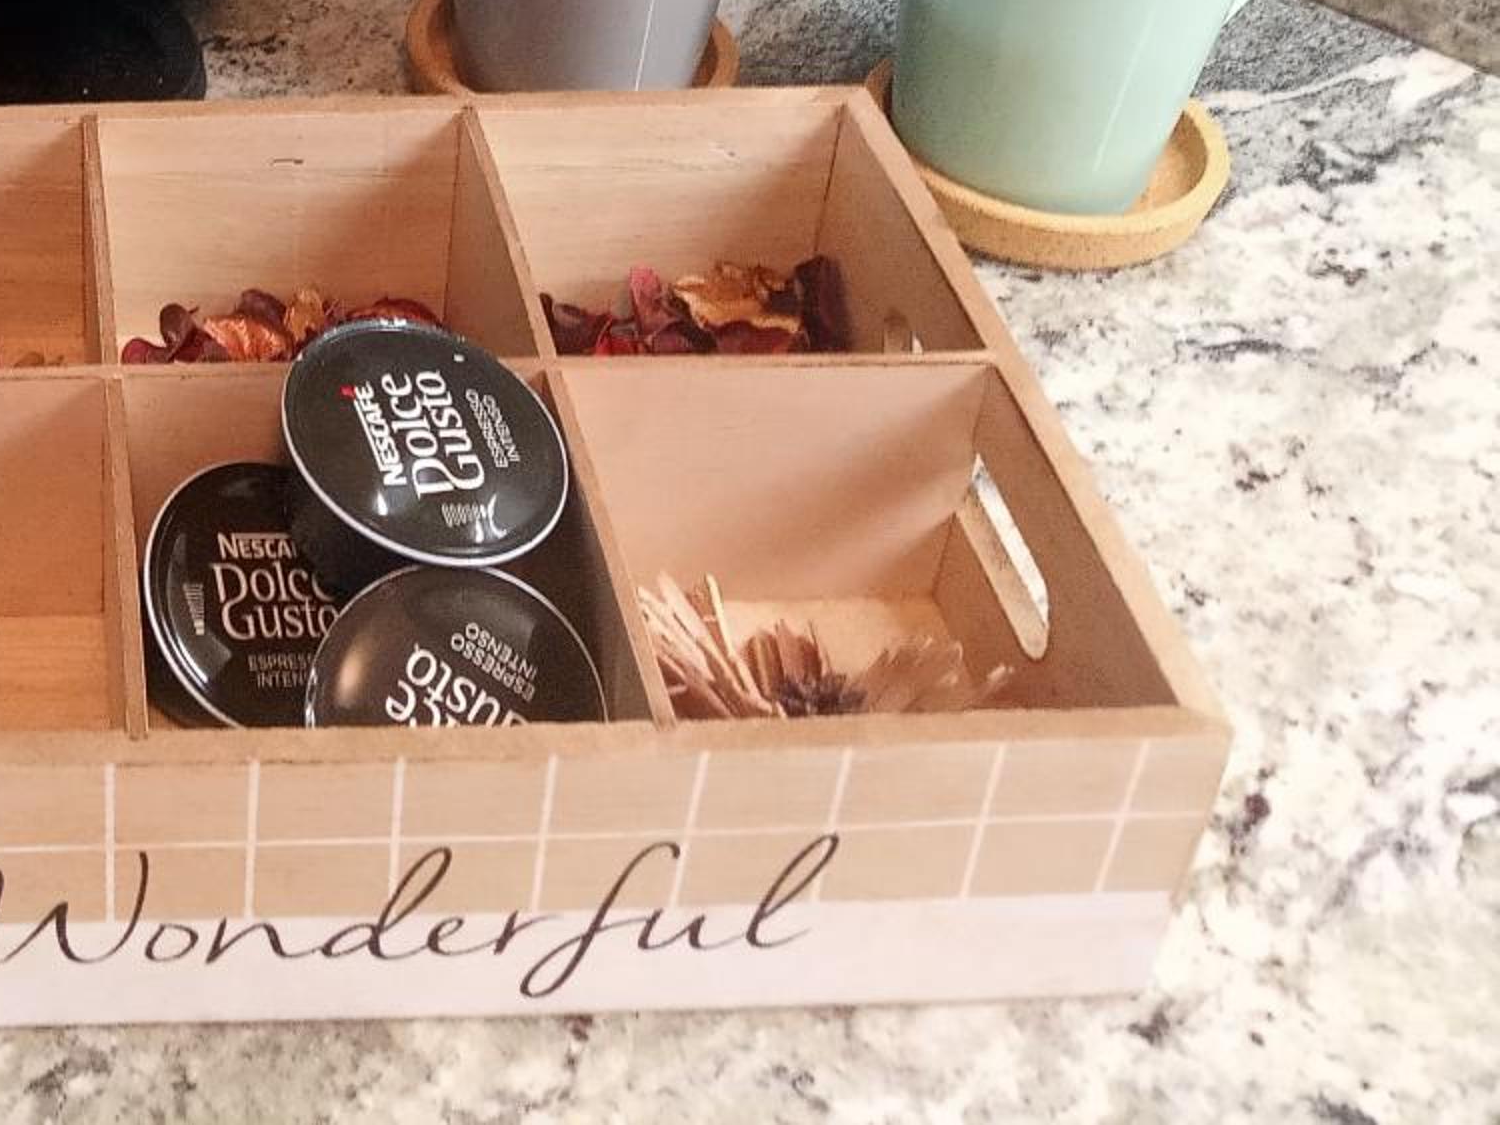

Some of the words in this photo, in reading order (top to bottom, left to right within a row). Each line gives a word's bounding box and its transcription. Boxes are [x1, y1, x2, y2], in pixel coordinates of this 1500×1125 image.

[381, 372, 454, 499] Dolce
[415, 369, 486, 491] Gusto
[217, 531, 297, 559] NESCA
[248, 654, 313, 672] ESPRES
[450, 632, 536, 702] ESPRESSO
[465, 622, 538, 680] INTENSO
